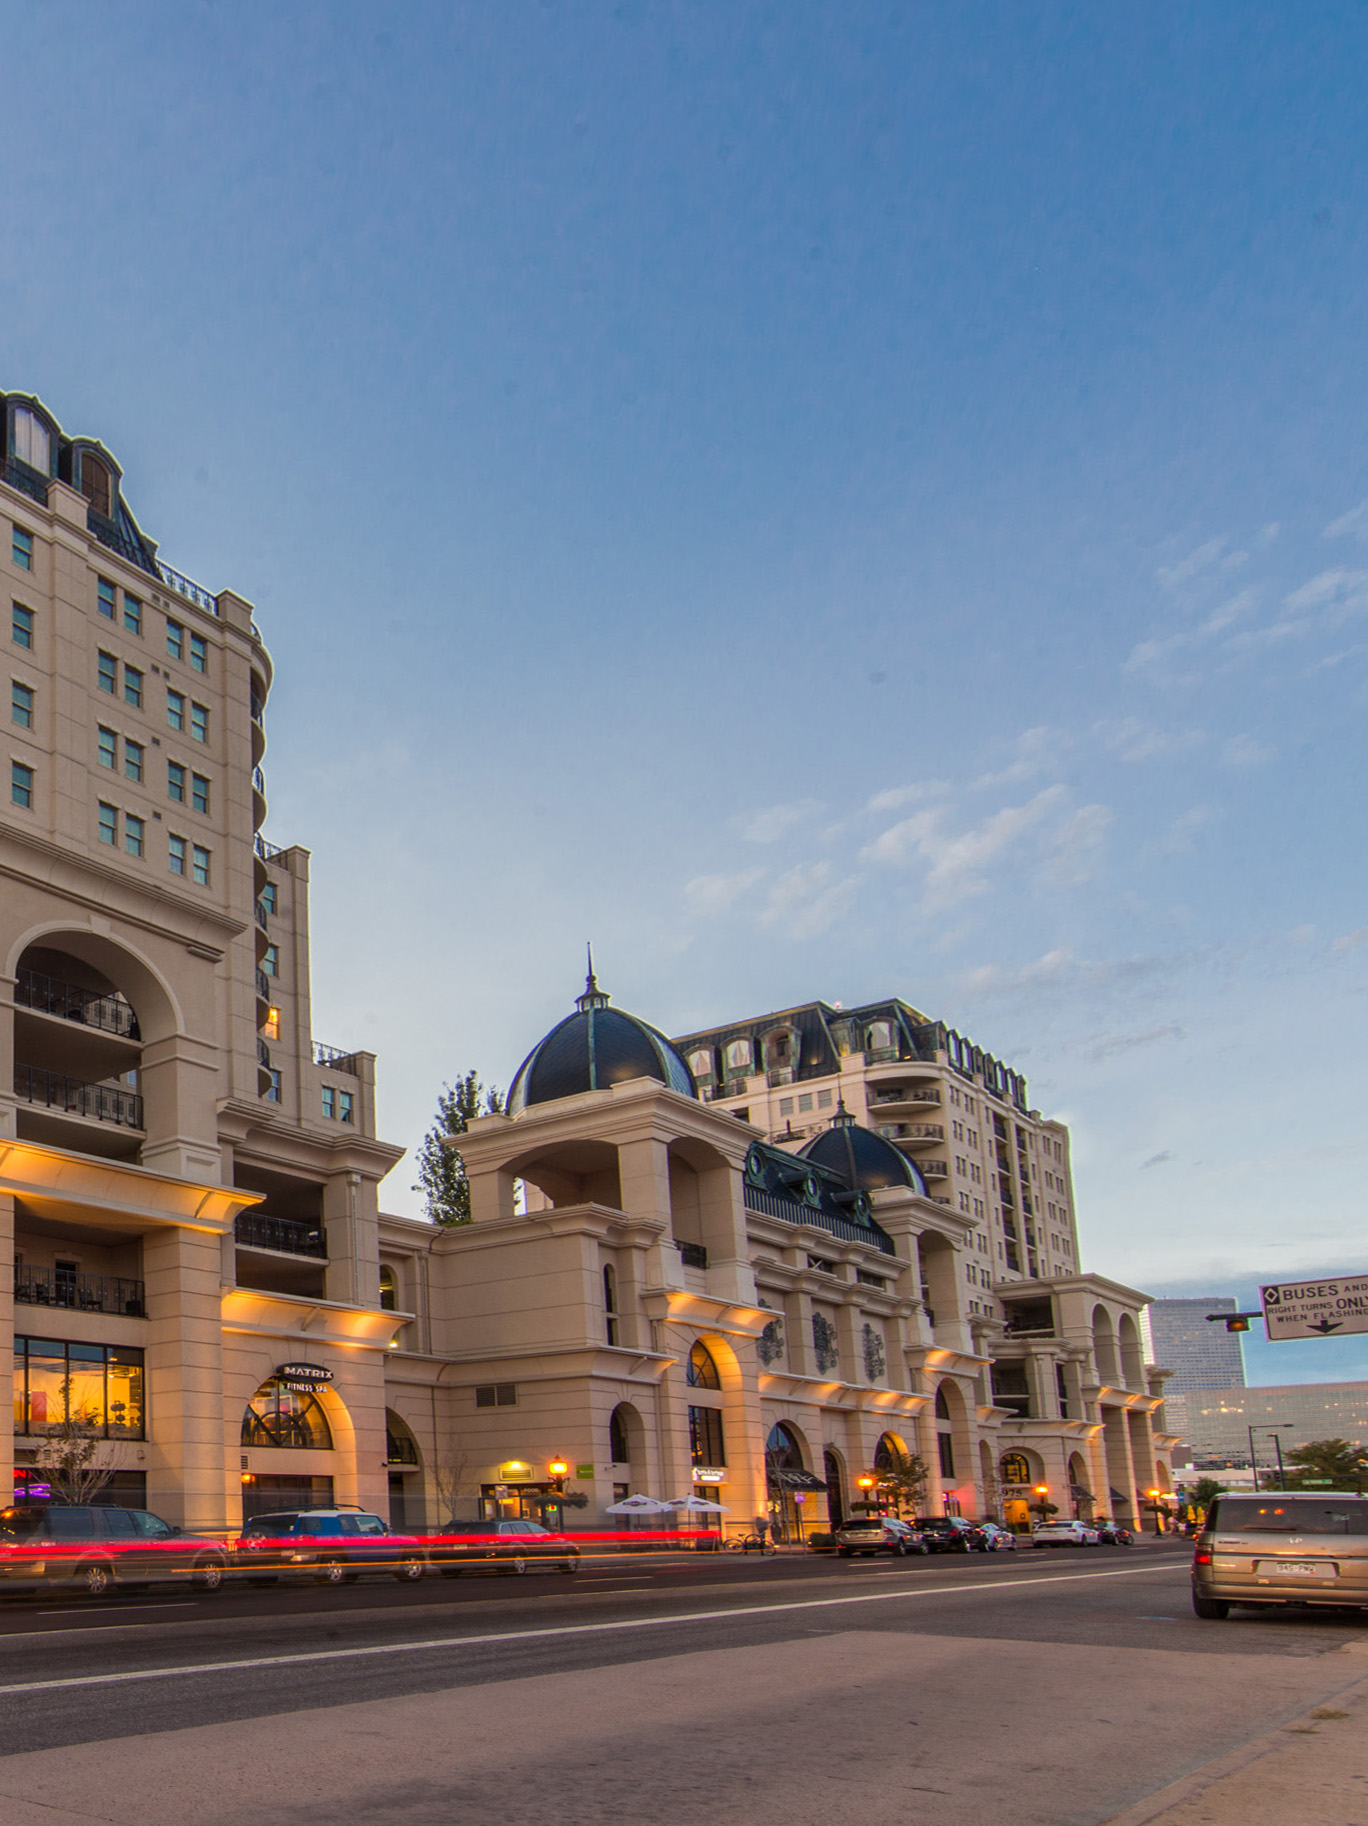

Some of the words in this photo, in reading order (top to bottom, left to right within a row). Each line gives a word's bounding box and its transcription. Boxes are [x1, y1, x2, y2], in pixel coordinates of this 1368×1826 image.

[1282, 1284, 1339, 1300] BUSES
[1344, 1283, 1368, 1293] AND
[1268, 1305, 1296, 1315] RIGHT
[1301, 1301, 1333, 1311] TURNS
[1276, 1313, 1308, 1323] WHEN
[283, 1366, 333, 1379] MATRIX
[287, 1383, 313, 1392] FITNESS
